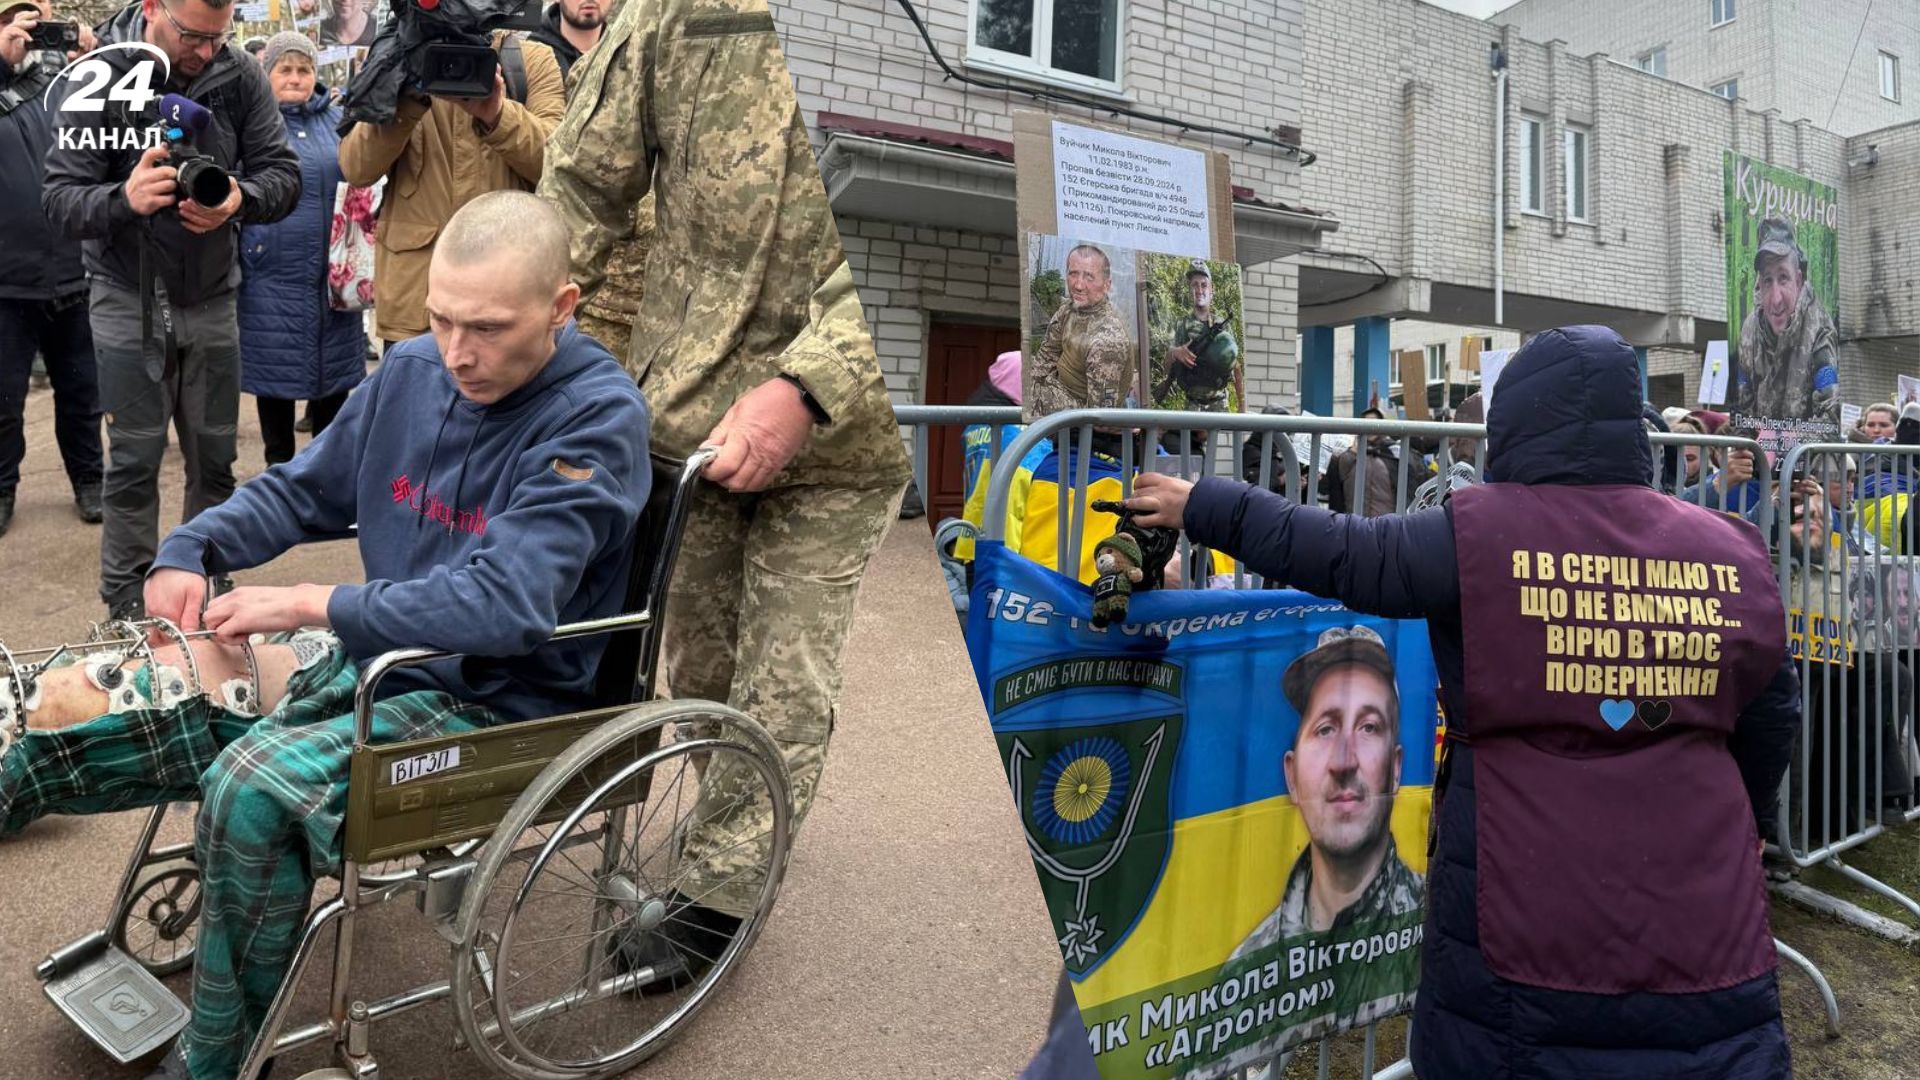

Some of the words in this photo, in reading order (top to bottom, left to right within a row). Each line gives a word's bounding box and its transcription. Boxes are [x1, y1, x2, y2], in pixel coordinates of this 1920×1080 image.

[1060, 136, 1090, 150] Вуйчик
[1092, 143, 1125, 157] Микола
[1127, 150, 1171, 167] Вікторович
[1088, 154, 1133, 170] 11.02.1983
[1061, 161, 1094, 176] Пропав
[1095, 167, 1132, 182] безвісти
[1133, 174, 1175, 190] 28.09.2024
[1062, 173, 1078, 183] 152
[1080, 177, 1119, 192] Єгерська
[1121, 184, 1153, 199] бригада
[1068, 186, 1155, 210] Прикомандирований
[1157, 204, 1168, 213] до
[1736, 160, 1836, 230] Курщина
[1064, 212, 1110, 226] населений
[1111, 220, 1135, 231] пункт
[1108, 206, 1161, 222] Покровський
[1512, 550, 1530, 579] Я
[1537, 551, 1556, 580] В
[1562, 553, 1639, 590] СЕРЦІ
[1645, 559, 1709, 590] МАЮ
[1712, 563, 1741, 593] ТЕ
[1520, 585, 1568, 622] ЩО
[1575, 590, 1608, 621] НЕ
[1613, 592, 1742, 627] ВМИРАЄ...
[1547, 624, 1621, 659] ВІРЮ
[1627, 628, 1645, 659] В
[1651, 630, 1722, 662] ТВОЄ
[1005, 680, 1022, 702] НЕ
[1025, 670, 1057, 694] СМІЄ
[1061, 663, 1092, 684] БУТИ
[1096, 661, 1105, 681] В
[1107, 660, 1132, 682] НАС
[1134, 663, 1174, 690] СТРАХУ
[1546, 661, 1720, 696] ПОВЕРНЕННЯ
[1140, 959, 1280, 1039] Микола
[1288, 924, 1423, 981] Вікторови
[1145, 977, 1336, 1069] «Агроном»
